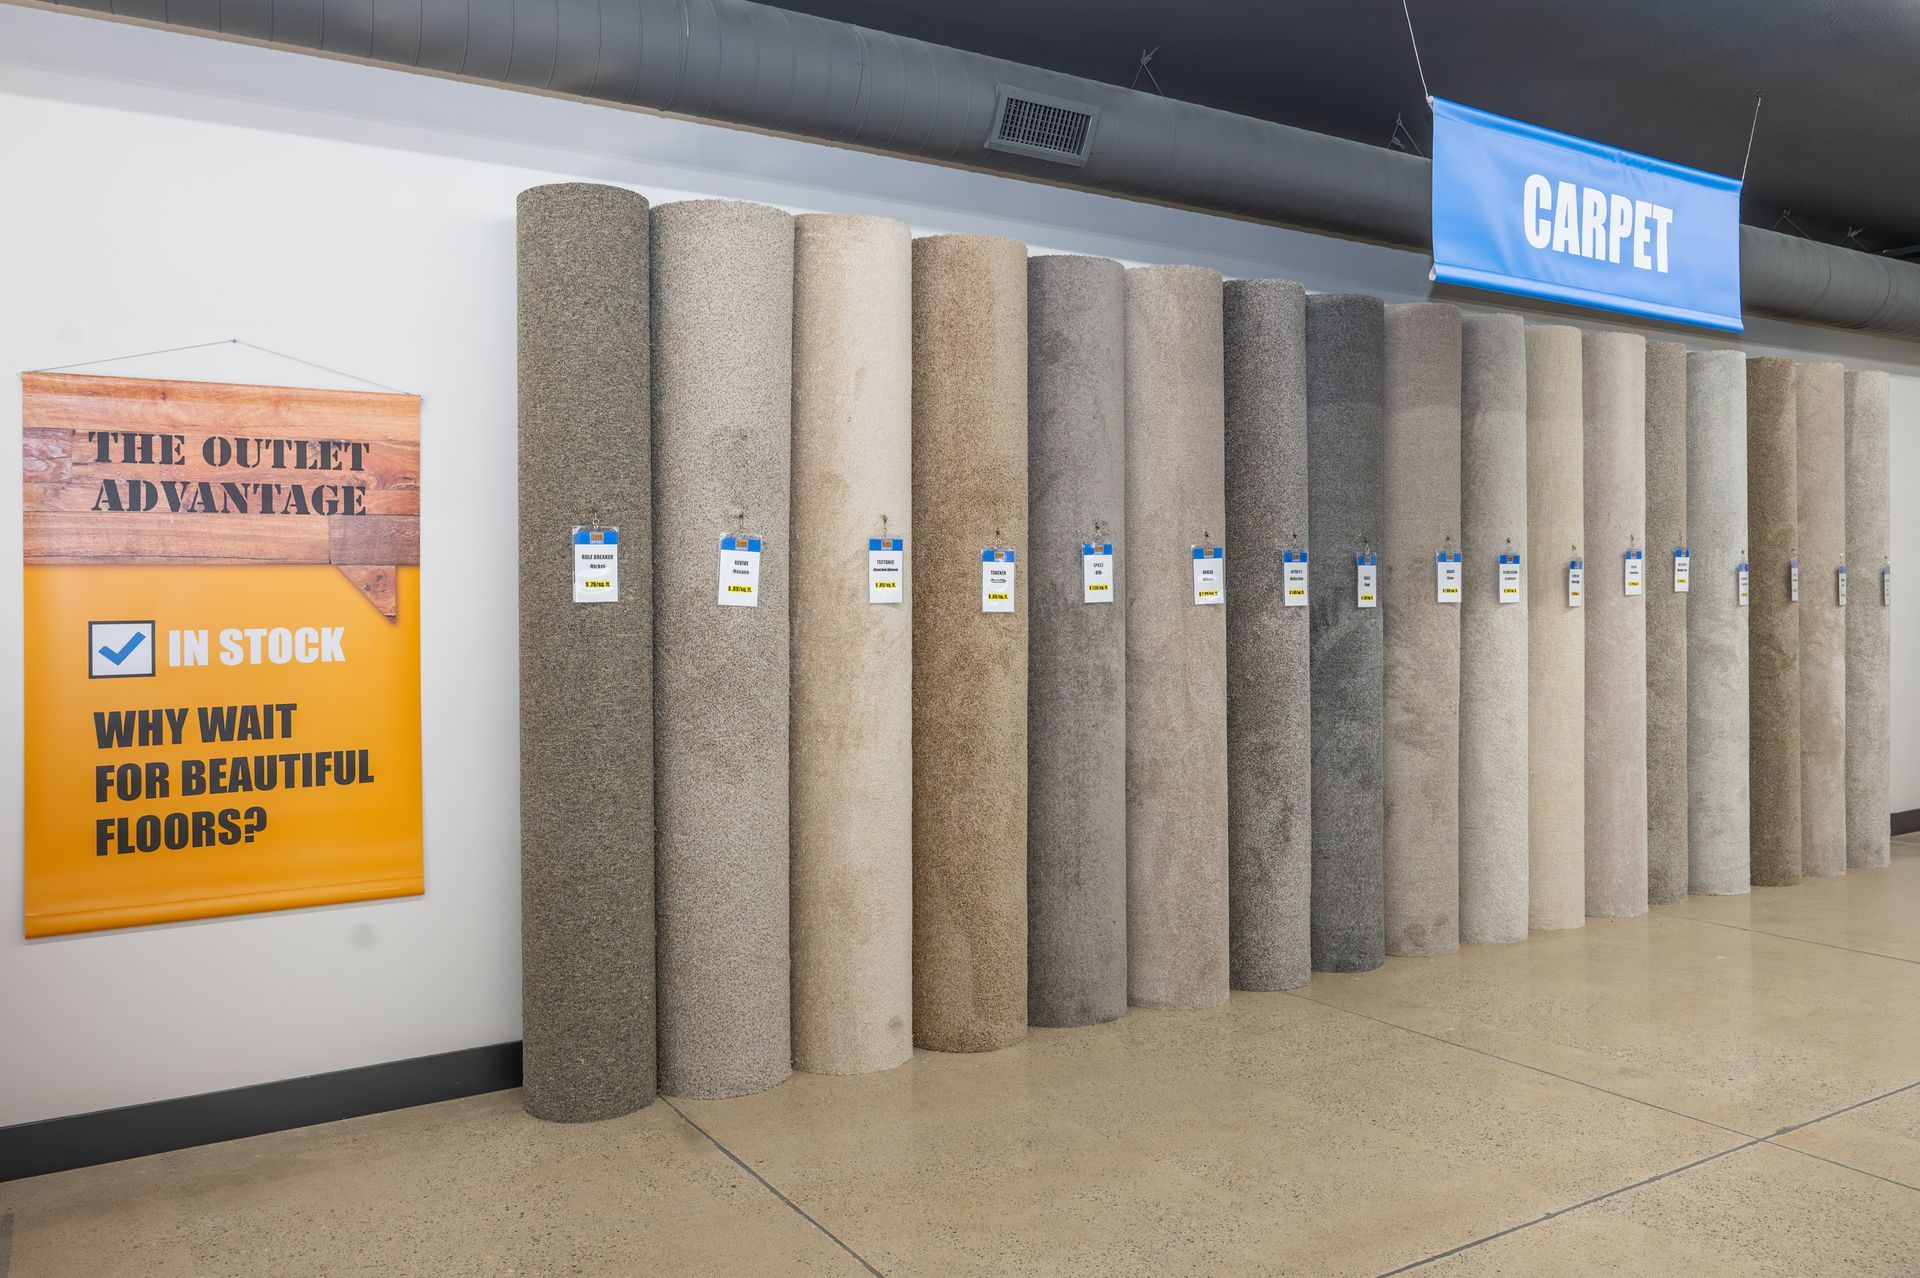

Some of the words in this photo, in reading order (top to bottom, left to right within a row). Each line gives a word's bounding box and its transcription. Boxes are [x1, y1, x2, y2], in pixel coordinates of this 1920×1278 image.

[1523, 173, 1673, 274] CARPET
[88, 430, 186, 465] THE
[201, 436, 370, 472] OUTLET
[90, 478, 367, 516] ADVANTAGE
[168, 629, 208, 667] IN
[219, 627, 346, 666] STOCK
[93, 707, 189, 749] WHY
[197, 703, 298, 743] WAIT
[95, 762, 170, 803] FOR
[181, 749, 374, 798] BEAUTIFUL
[96, 806, 267, 857] FLOORS?
